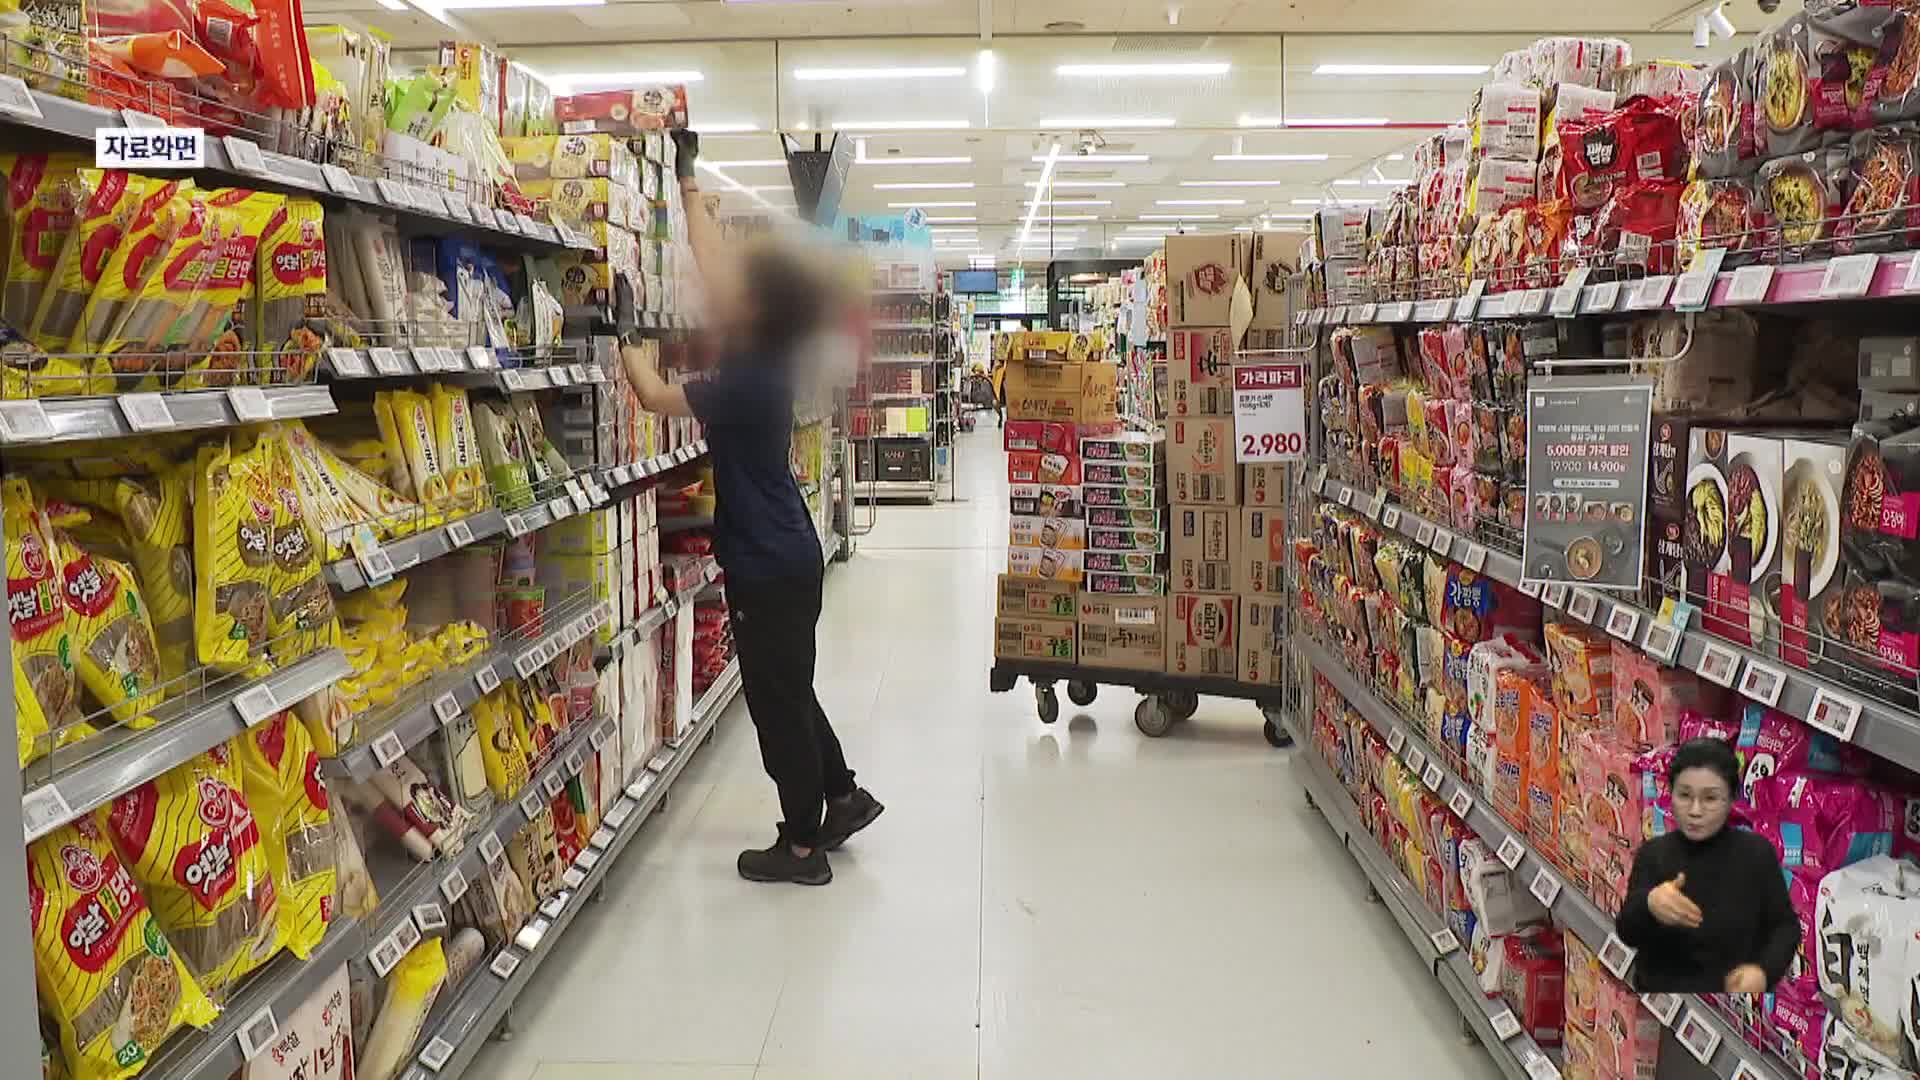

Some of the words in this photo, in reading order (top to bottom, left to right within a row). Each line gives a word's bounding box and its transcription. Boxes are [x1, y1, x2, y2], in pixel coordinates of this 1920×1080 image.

[276, 252, 299, 270] 옛날
[1242, 432, 1302, 456] 2,980
[275, 527, 306, 561] 옛날
[69, 564, 102, 604] 옛날
[1449, 580, 1481, 608] 간짬뽕
[186, 831, 233, 895] 옛날
[69, 902, 109, 956] 옛날
[279, 1031, 300, 1054] 백설
